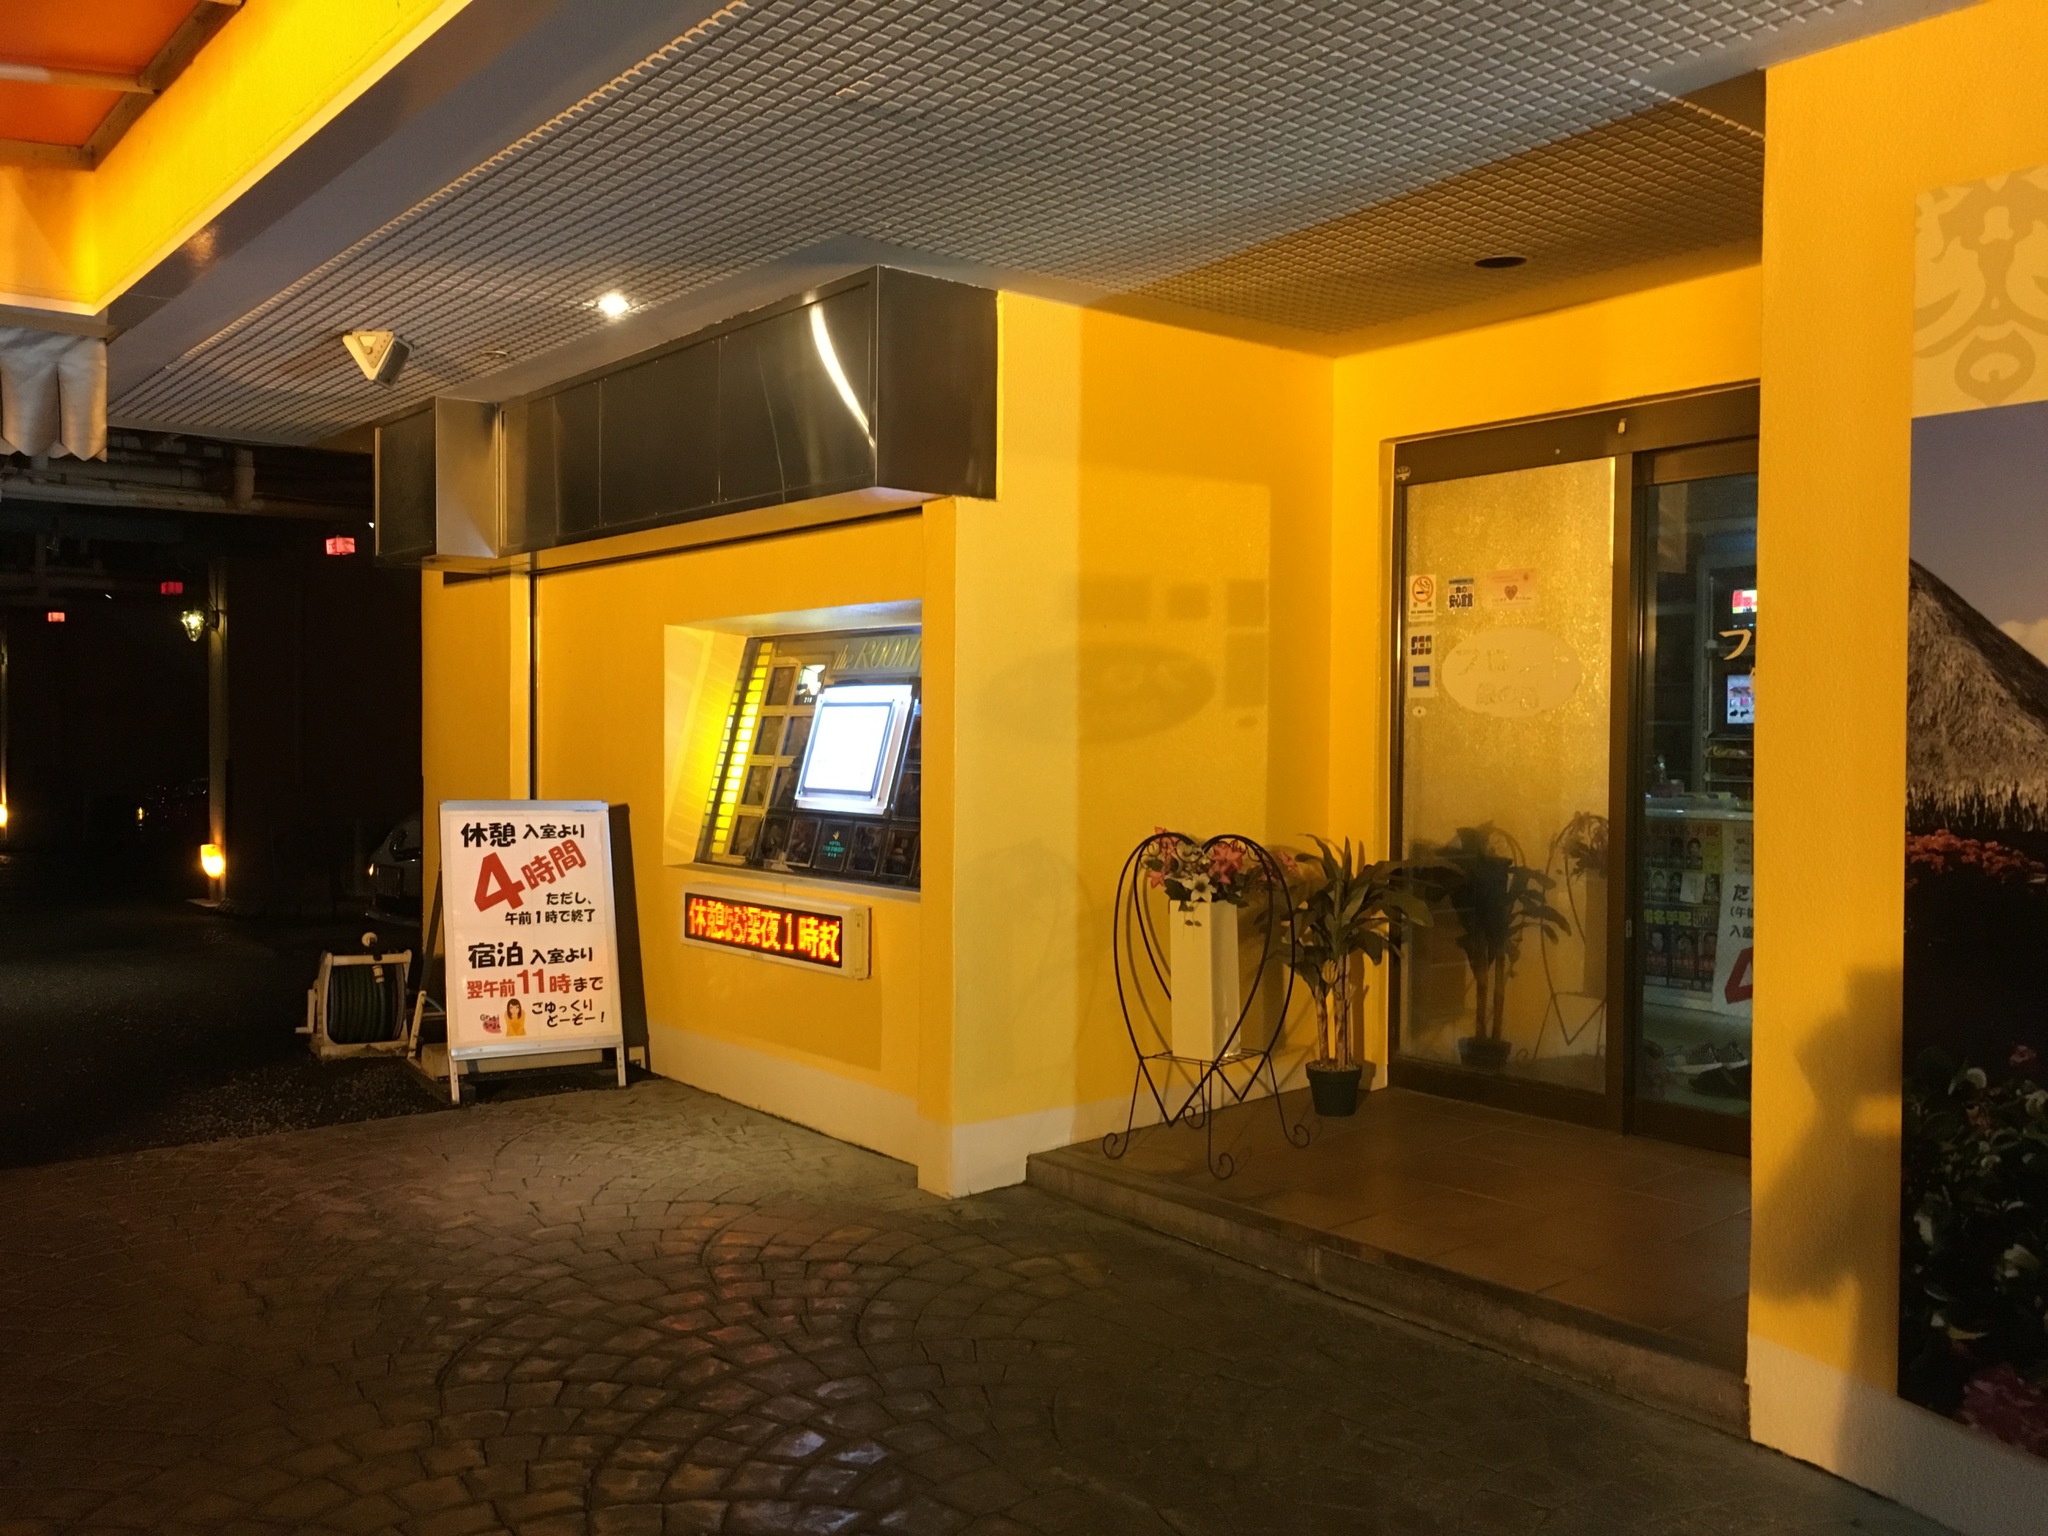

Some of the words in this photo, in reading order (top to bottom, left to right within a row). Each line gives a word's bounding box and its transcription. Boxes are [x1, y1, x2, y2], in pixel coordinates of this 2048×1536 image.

[854, 637, 921, 670] ROOM
[460, 822, 516, 848] 休憩
[523, 822, 586, 840] 入室より
[474, 839, 588, 913] 4時間
[546, 891, 593, 906] ただし、
[505, 908, 596, 926] 午前1時で終了
[468, 941, 524, 969] 宿泊
[530, 948, 593, 965] 入室より
[467, 969, 604, 999] 翌午前11時まで
[531, 999, 593, 1015] ごゆっくり
